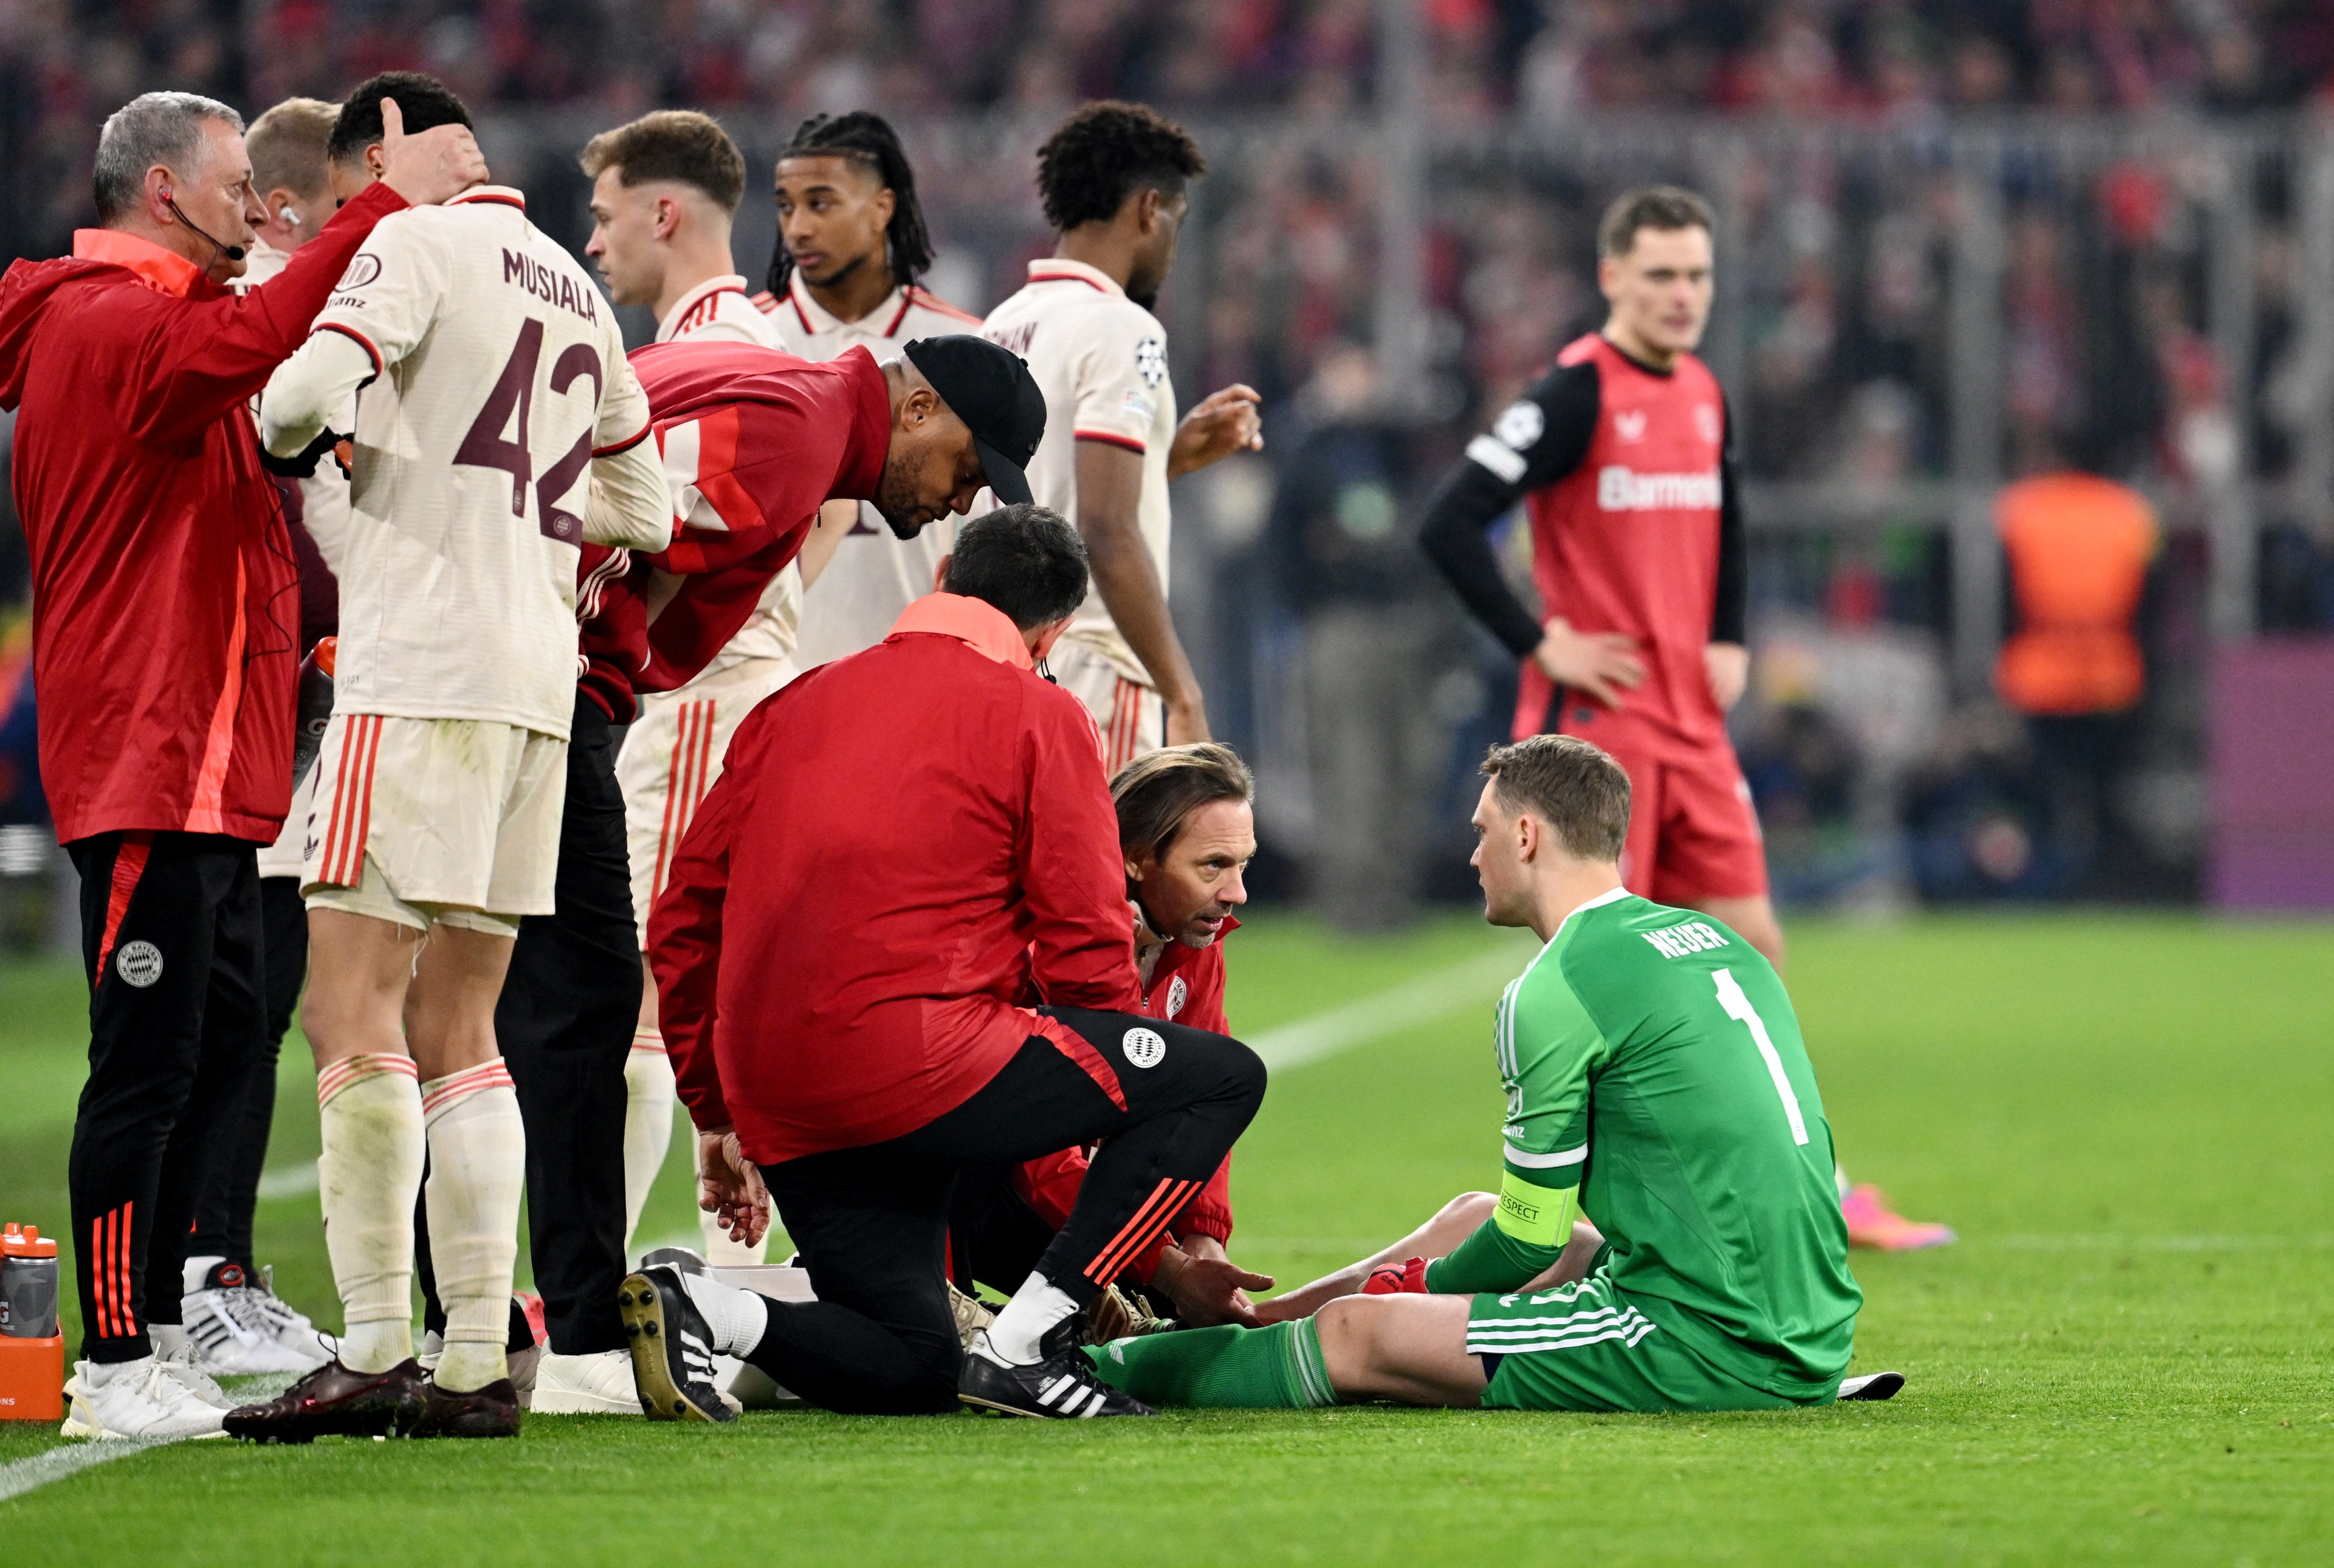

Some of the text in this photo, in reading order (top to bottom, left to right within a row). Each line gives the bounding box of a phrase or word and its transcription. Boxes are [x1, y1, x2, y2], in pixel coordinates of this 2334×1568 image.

[502, 247, 597, 328] MUSIALA
[452, 316, 602, 550] 42
[1641, 922, 1730, 959] NEUER
[1127, 1031, 1146, 1059] FC BAYERN
[1711, 968, 1809, 1146] 1
[1500, 1192, 1540, 1220] RESPECT
